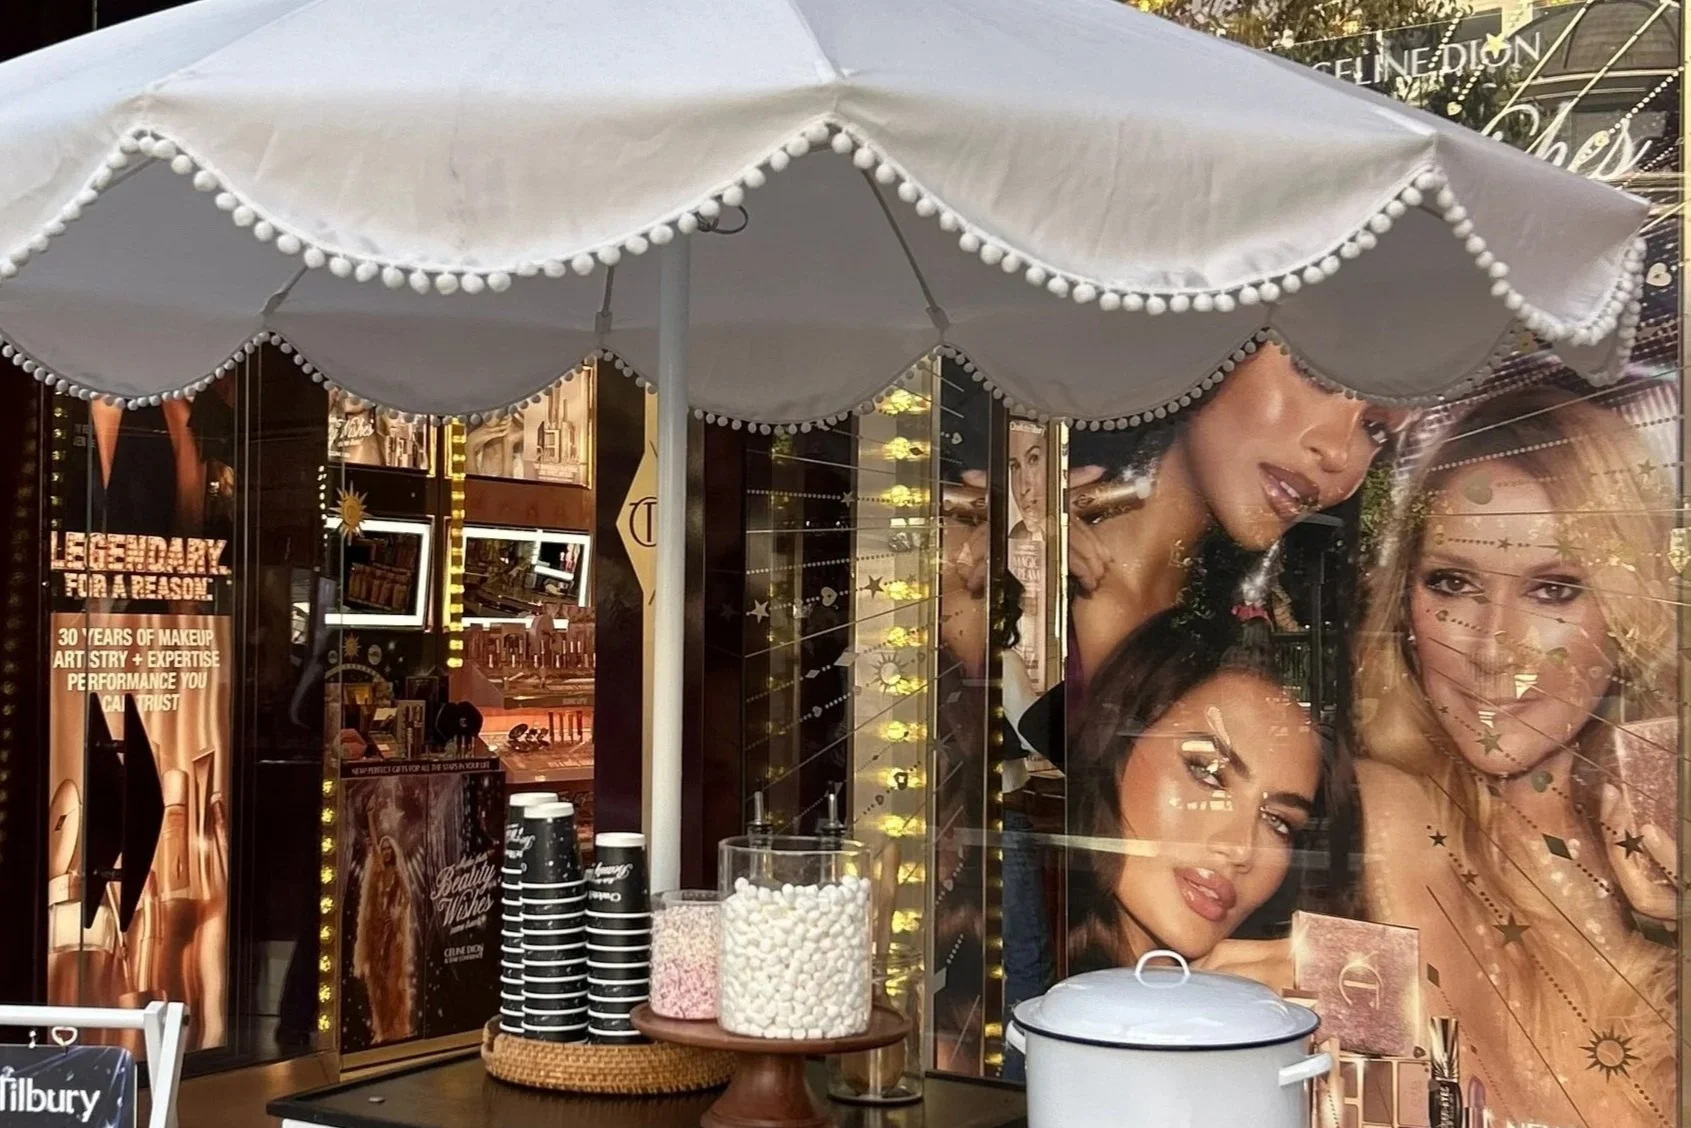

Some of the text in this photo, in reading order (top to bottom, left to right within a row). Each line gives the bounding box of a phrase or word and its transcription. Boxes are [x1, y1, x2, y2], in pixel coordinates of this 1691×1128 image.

[1442, 31, 1541, 74] DION
[64, 572, 107, 599] FOR
[112, 574, 127, 599] A
[58, 628, 214, 647] 30 YEARS OF MAKEUP
[53, 651, 128, 669] ARTSTRY
[147, 651, 221, 668] EXPERTISE
[67, 672, 208, 691] PERFORMANCE YOU
[137, 694, 180, 713] TRUST
[430, 861, 496, 901] Beauty
[438, 889, 494, 927] Wishes
